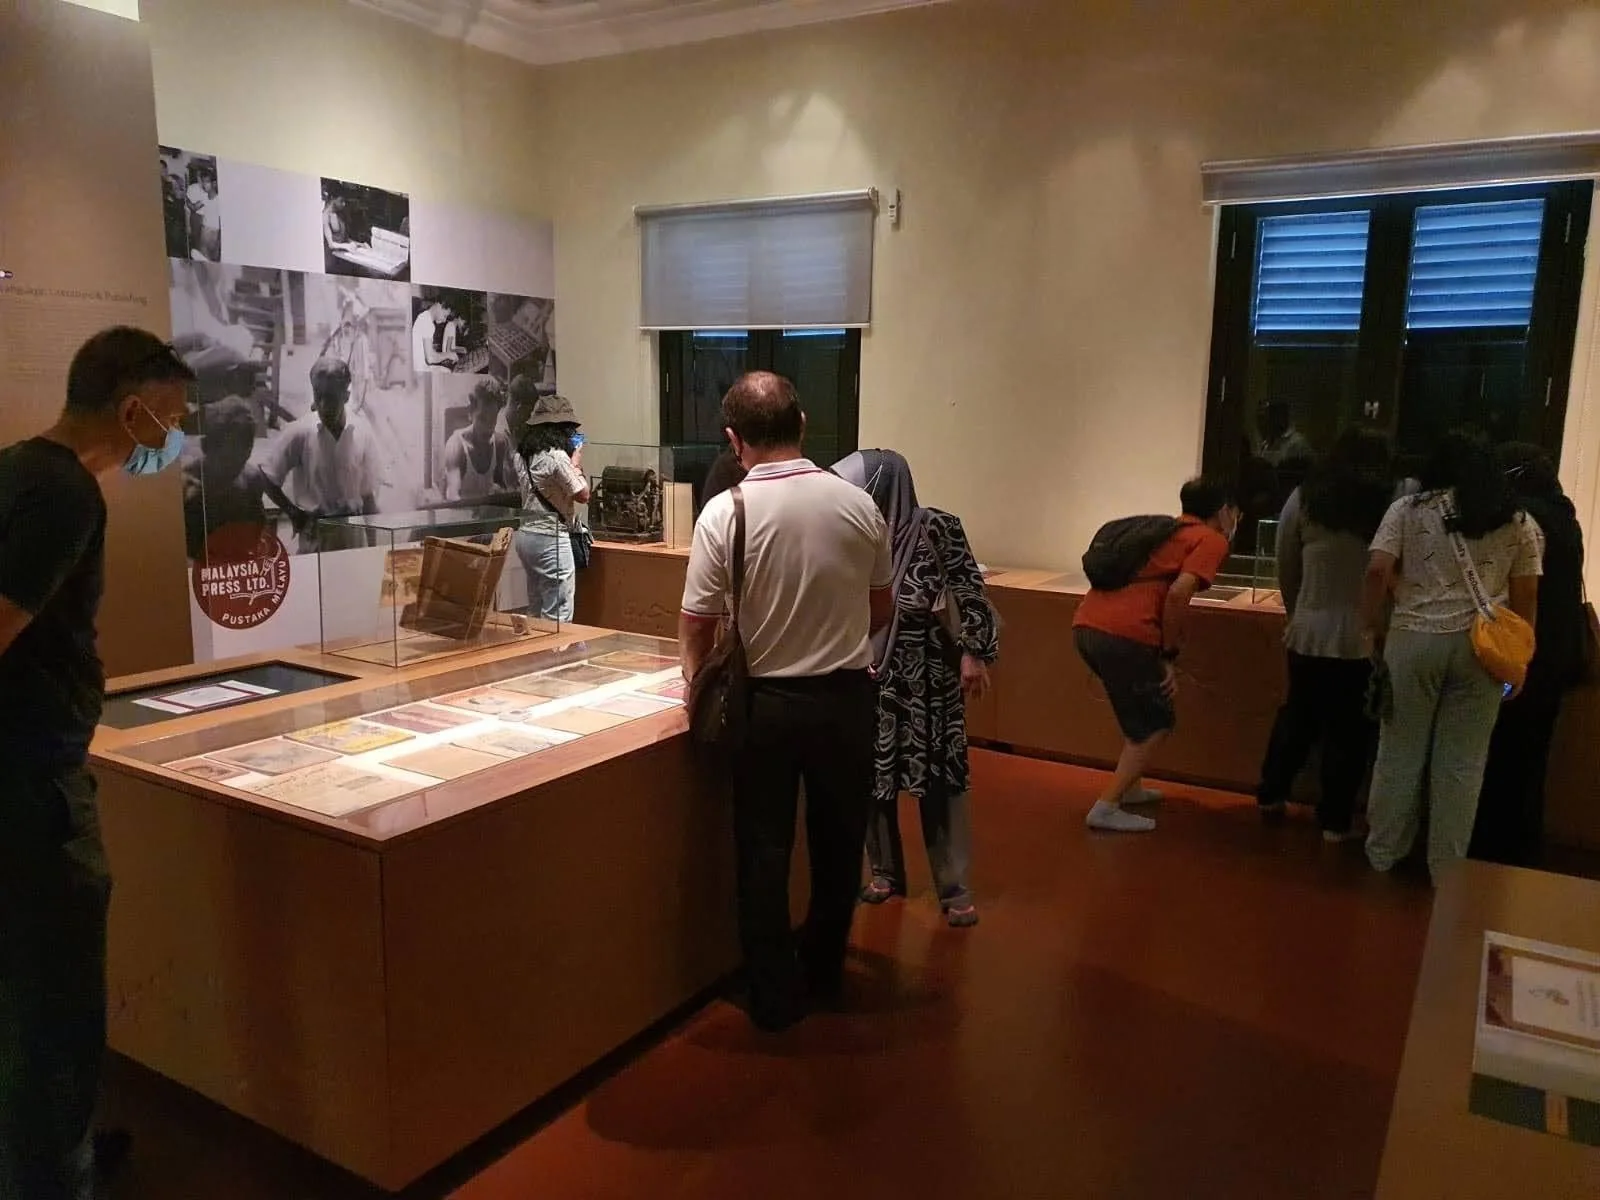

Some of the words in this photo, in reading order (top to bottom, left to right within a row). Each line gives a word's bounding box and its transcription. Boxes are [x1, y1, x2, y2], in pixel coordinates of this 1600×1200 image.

[201, 562, 259, 581] MALAYSIA
[202, 579, 240, 597] PRESS
[246, 577, 270, 590] LTD.
[222, 608, 270, 624] PUSTAKA
[271, 560, 287, 605] MELAYU
